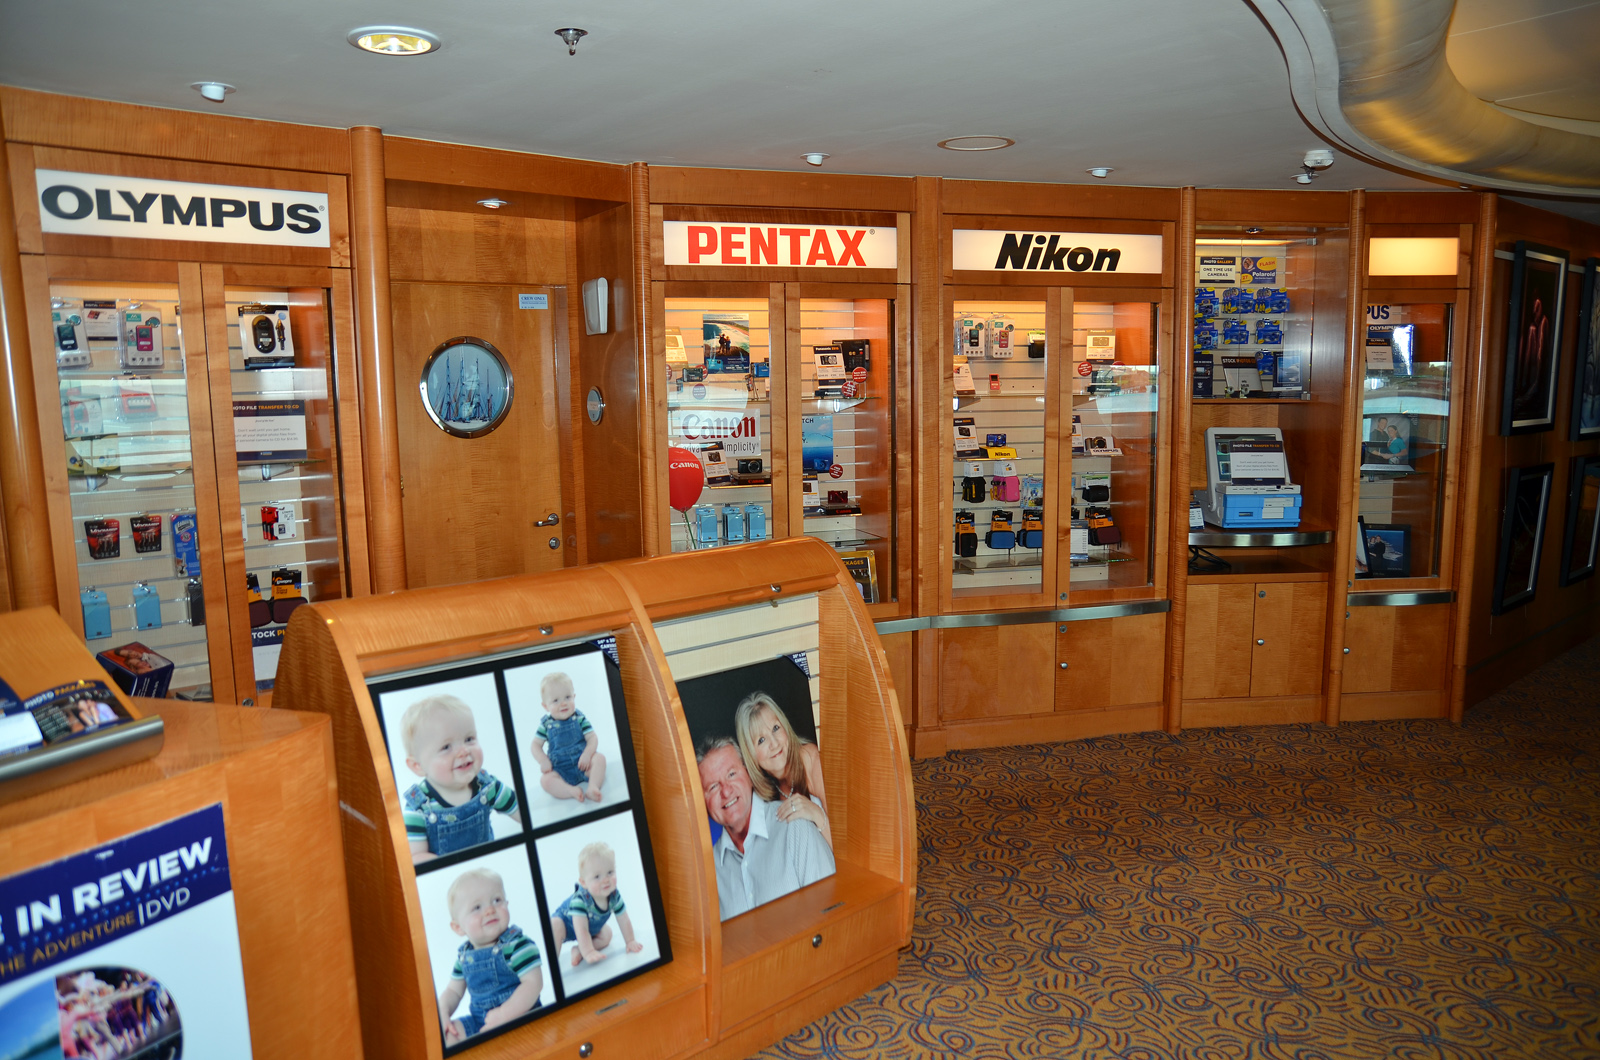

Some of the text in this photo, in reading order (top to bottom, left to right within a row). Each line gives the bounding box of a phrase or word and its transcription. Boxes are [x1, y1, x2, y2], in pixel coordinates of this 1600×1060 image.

[41, 185, 321, 234] OLYMPUS
[687, 225, 867, 266] PENTAX
[994, 233, 1121, 272] Nikon
[682, 413, 756, 440] Canon
[24, 691, 54, 710] PHOTO
[15, 893, 63, 937] IN
[72, 836, 212, 916] REVIEW
[31, 909, 136, 964] ADVENTURE
